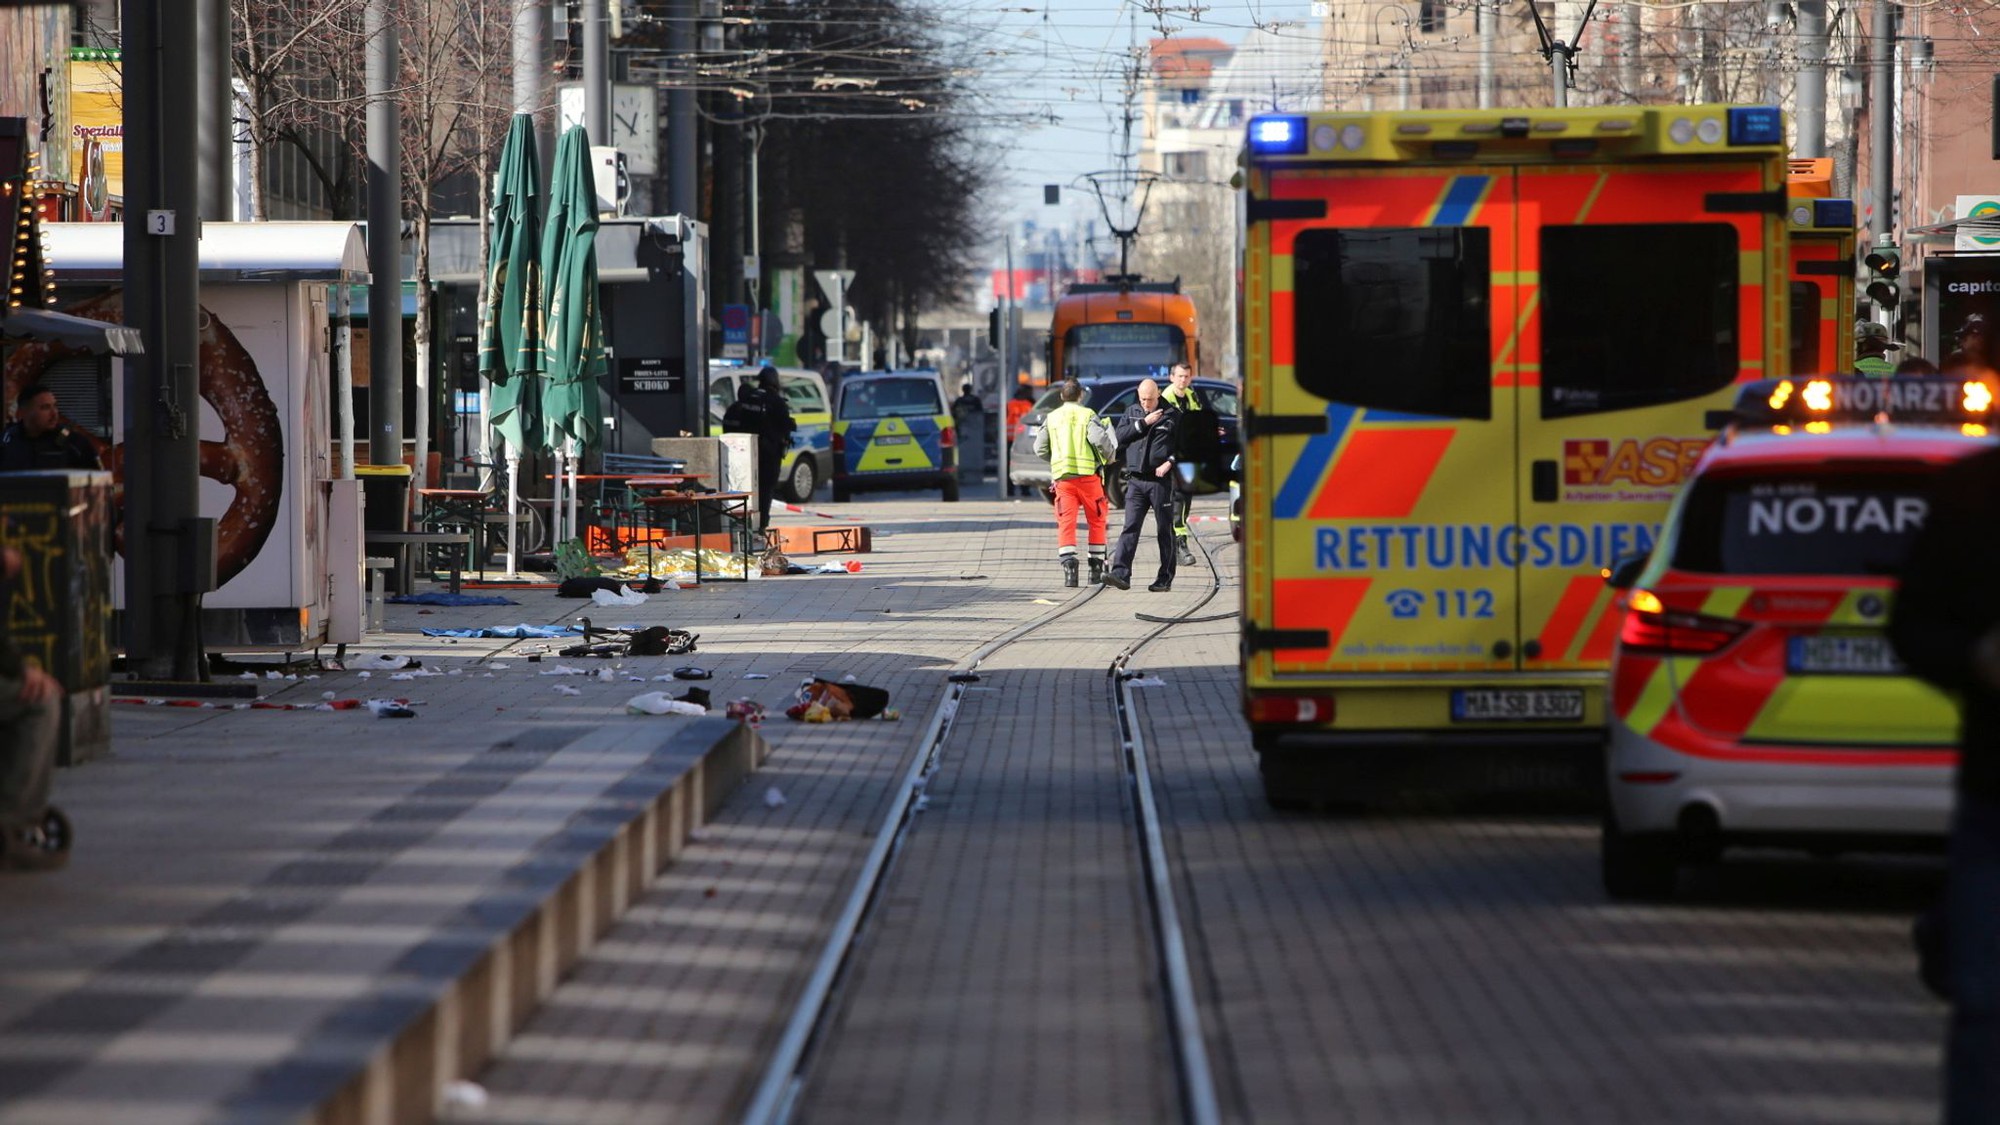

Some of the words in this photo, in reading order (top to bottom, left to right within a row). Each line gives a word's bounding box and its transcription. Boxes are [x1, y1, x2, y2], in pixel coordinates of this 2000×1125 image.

[157, 215, 165, 232] 3
[634, 381, 670, 391] SCHOKO
[1836, 381, 1958, 410] NOTARZT
[1750, 497, 1928, 535] NOTAR
[1435, 590, 1495, 618] 112
